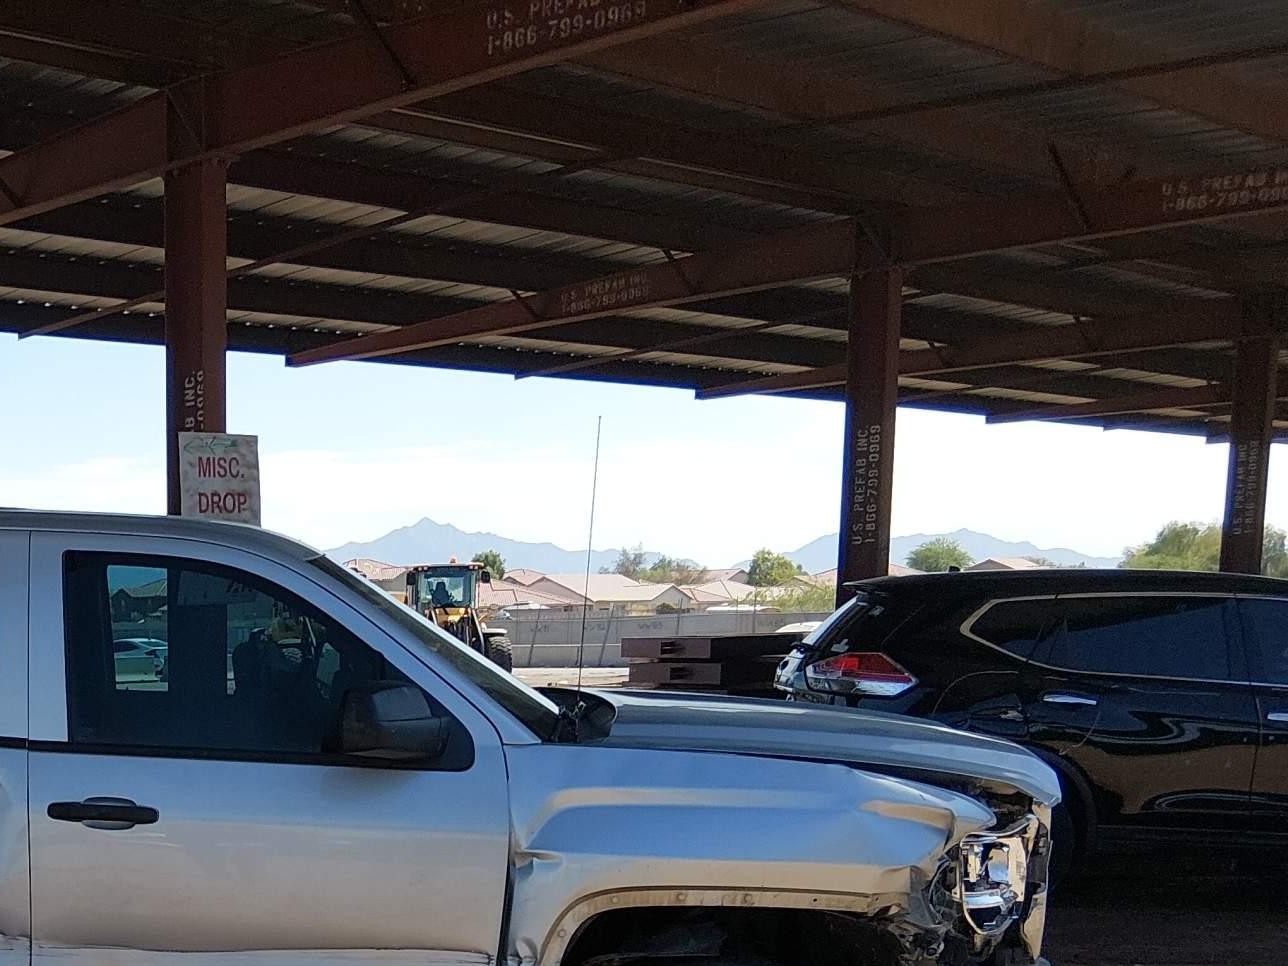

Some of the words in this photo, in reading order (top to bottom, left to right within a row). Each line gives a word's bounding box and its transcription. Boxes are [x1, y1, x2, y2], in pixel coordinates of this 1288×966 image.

[184, 370, 196, 407] INC.
[197, 456, 245, 479] MISC.
[854, 457, 867, 513] PREFAB
[197, 491, 248, 514] DROP
